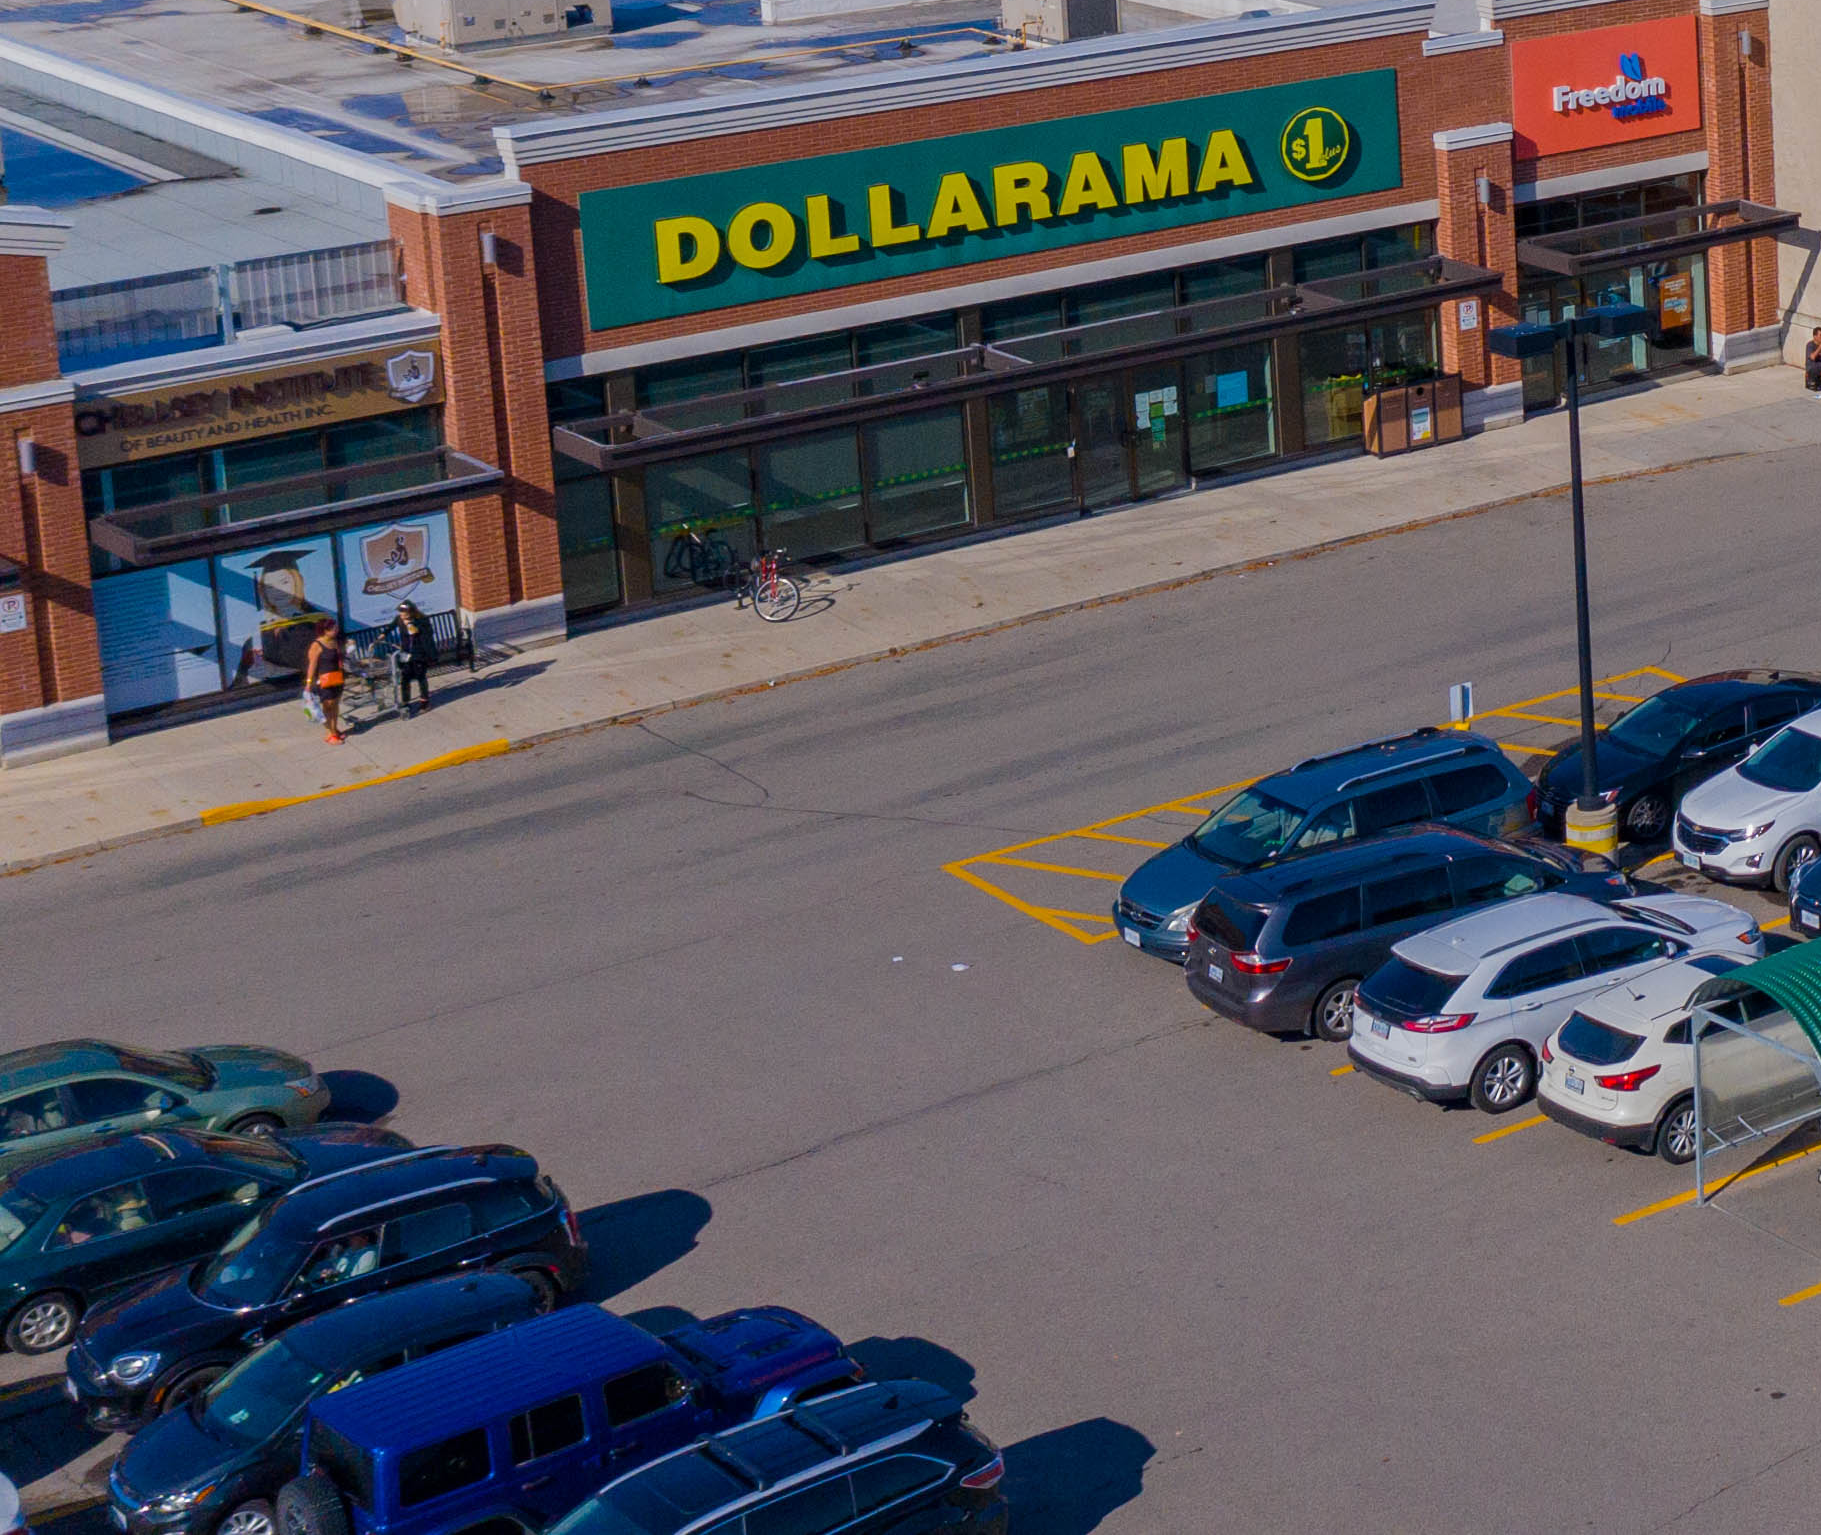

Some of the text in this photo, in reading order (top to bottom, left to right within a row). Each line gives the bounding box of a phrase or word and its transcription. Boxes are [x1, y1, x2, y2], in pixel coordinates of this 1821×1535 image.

[1553, 75, 1665, 111] Freedom
[654, 129, 1253, 285] DOLLARAMA
[120, 437, 145, 452] OF
[147, 425, 203, 448] BEAUTY
[207, 421, 241, 438] AND
[244, 410, 304, 430] HEALTH
